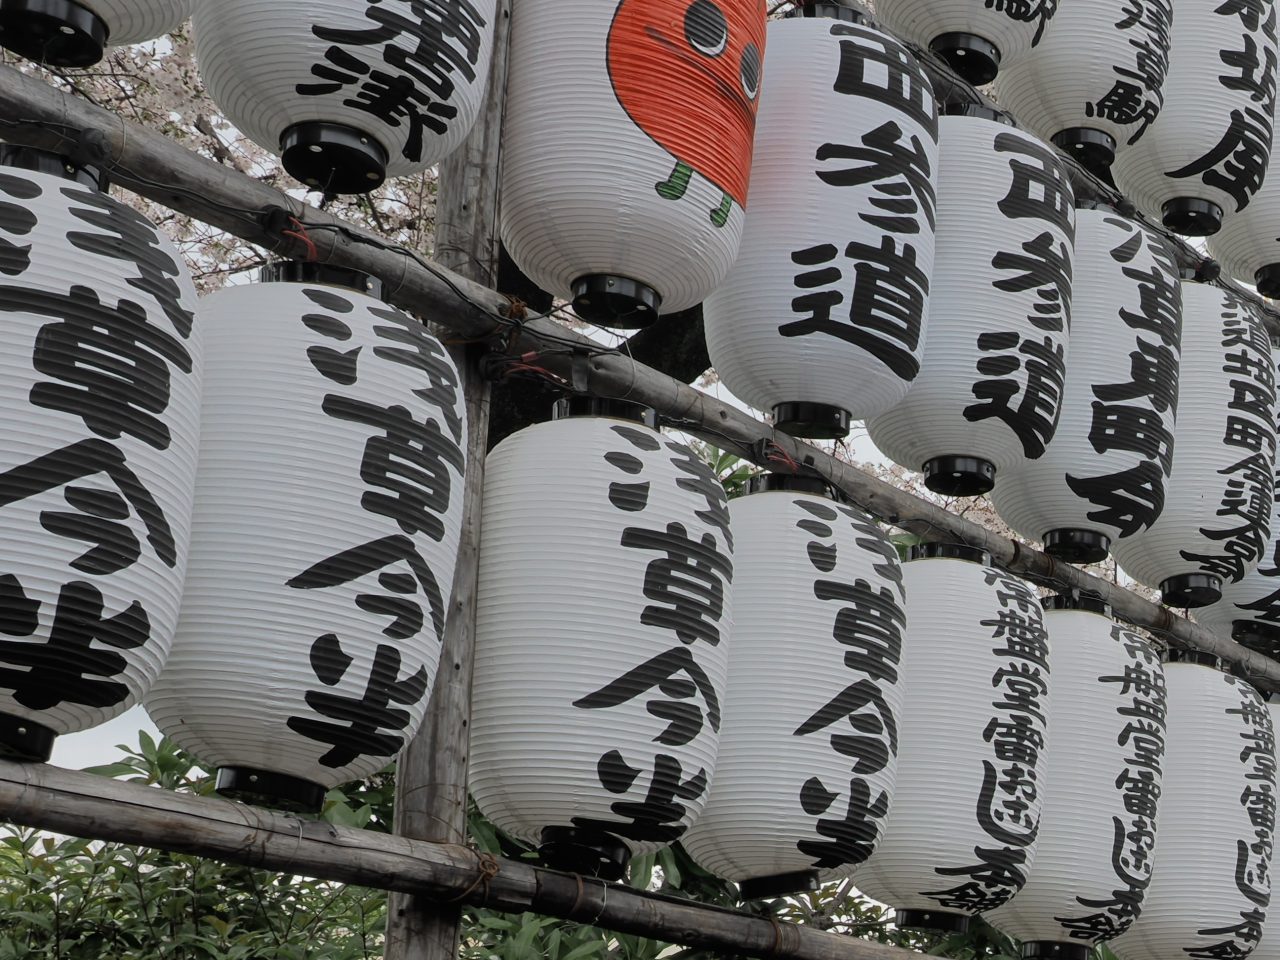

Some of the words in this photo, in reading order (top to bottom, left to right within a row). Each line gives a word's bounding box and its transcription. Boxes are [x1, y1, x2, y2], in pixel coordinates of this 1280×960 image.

[778, 23, 939, 382] 西参道
[963, 132, 1076, 459] 西参道
[286, 288, 466, 768] 浅草今半
[570, 425, 735, 843] 浅草今半
[793, 499, 908, 869] 浅草今半
